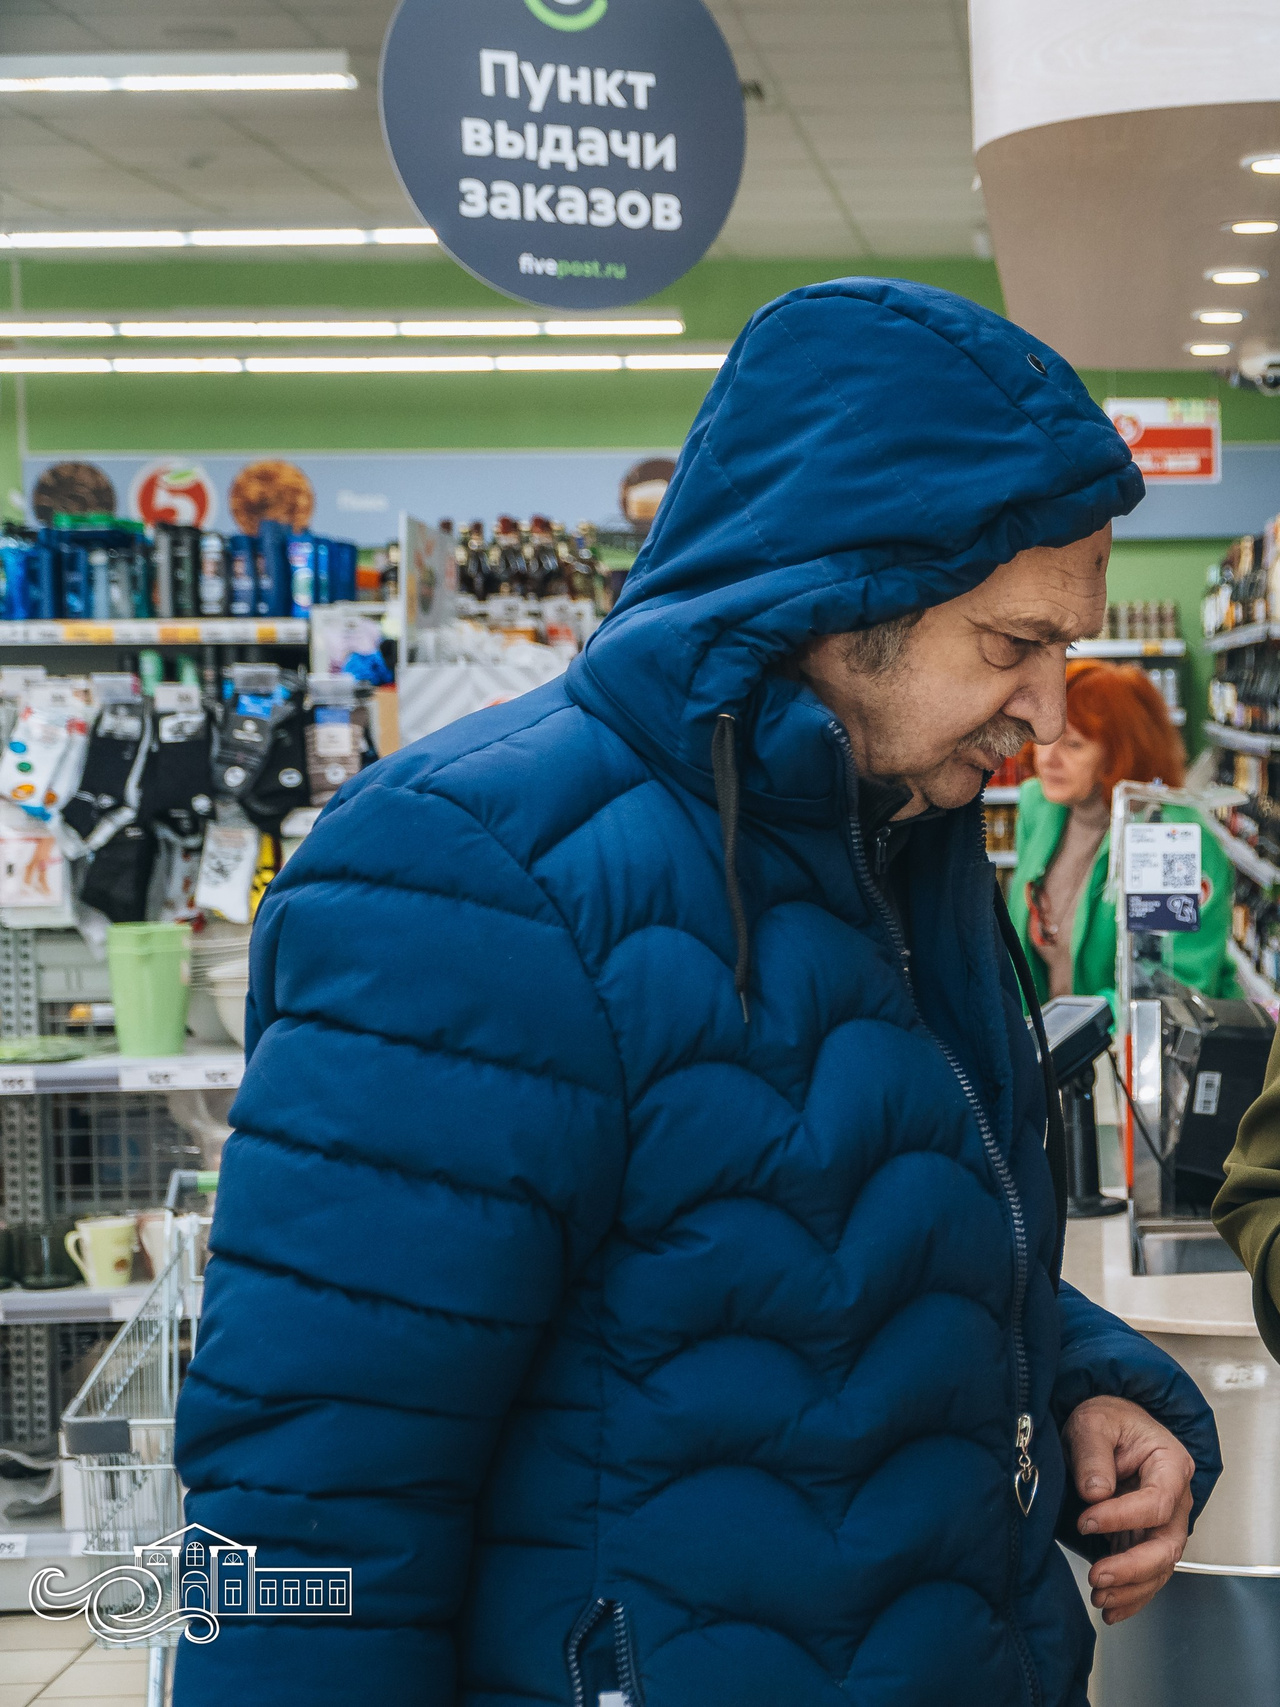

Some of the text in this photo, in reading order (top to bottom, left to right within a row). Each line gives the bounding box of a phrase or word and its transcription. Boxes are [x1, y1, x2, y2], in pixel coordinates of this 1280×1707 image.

[479, 48, 657, 112] Пункт
[460, 117, 677, 172] выдачи
[458, 178, 683, 231] заказов
[518, 252, 627, 280] fivepost.ru
